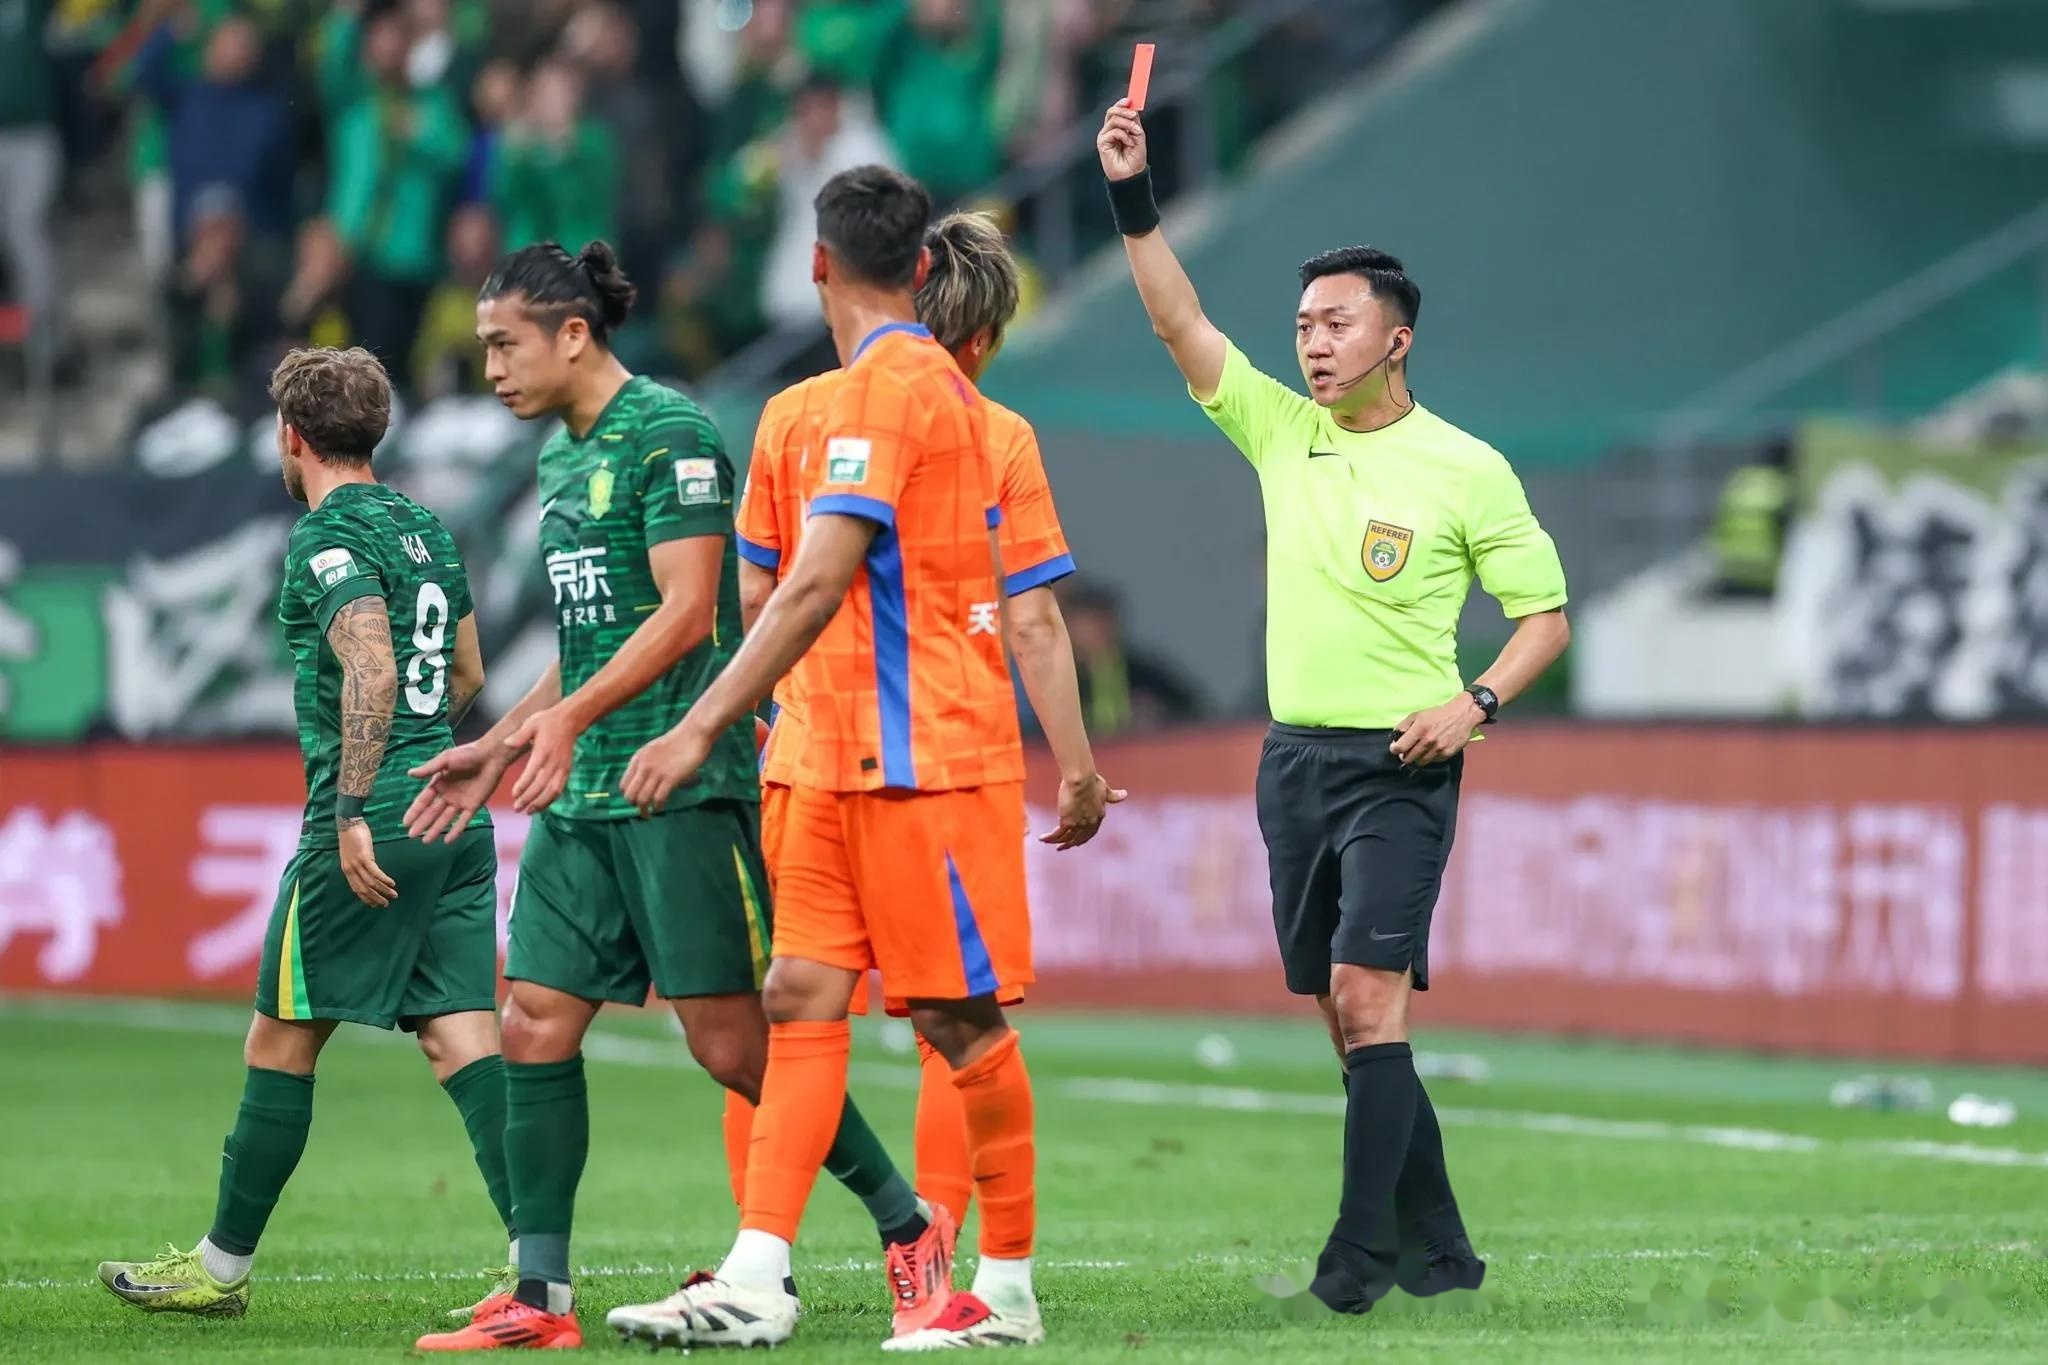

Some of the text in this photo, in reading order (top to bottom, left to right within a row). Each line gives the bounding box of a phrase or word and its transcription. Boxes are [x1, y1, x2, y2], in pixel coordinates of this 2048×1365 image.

[1370, 525, 1409, 541] REFEREE
[546, 546, 612, 604] 京东
[405, 582, 448, 715] 8
